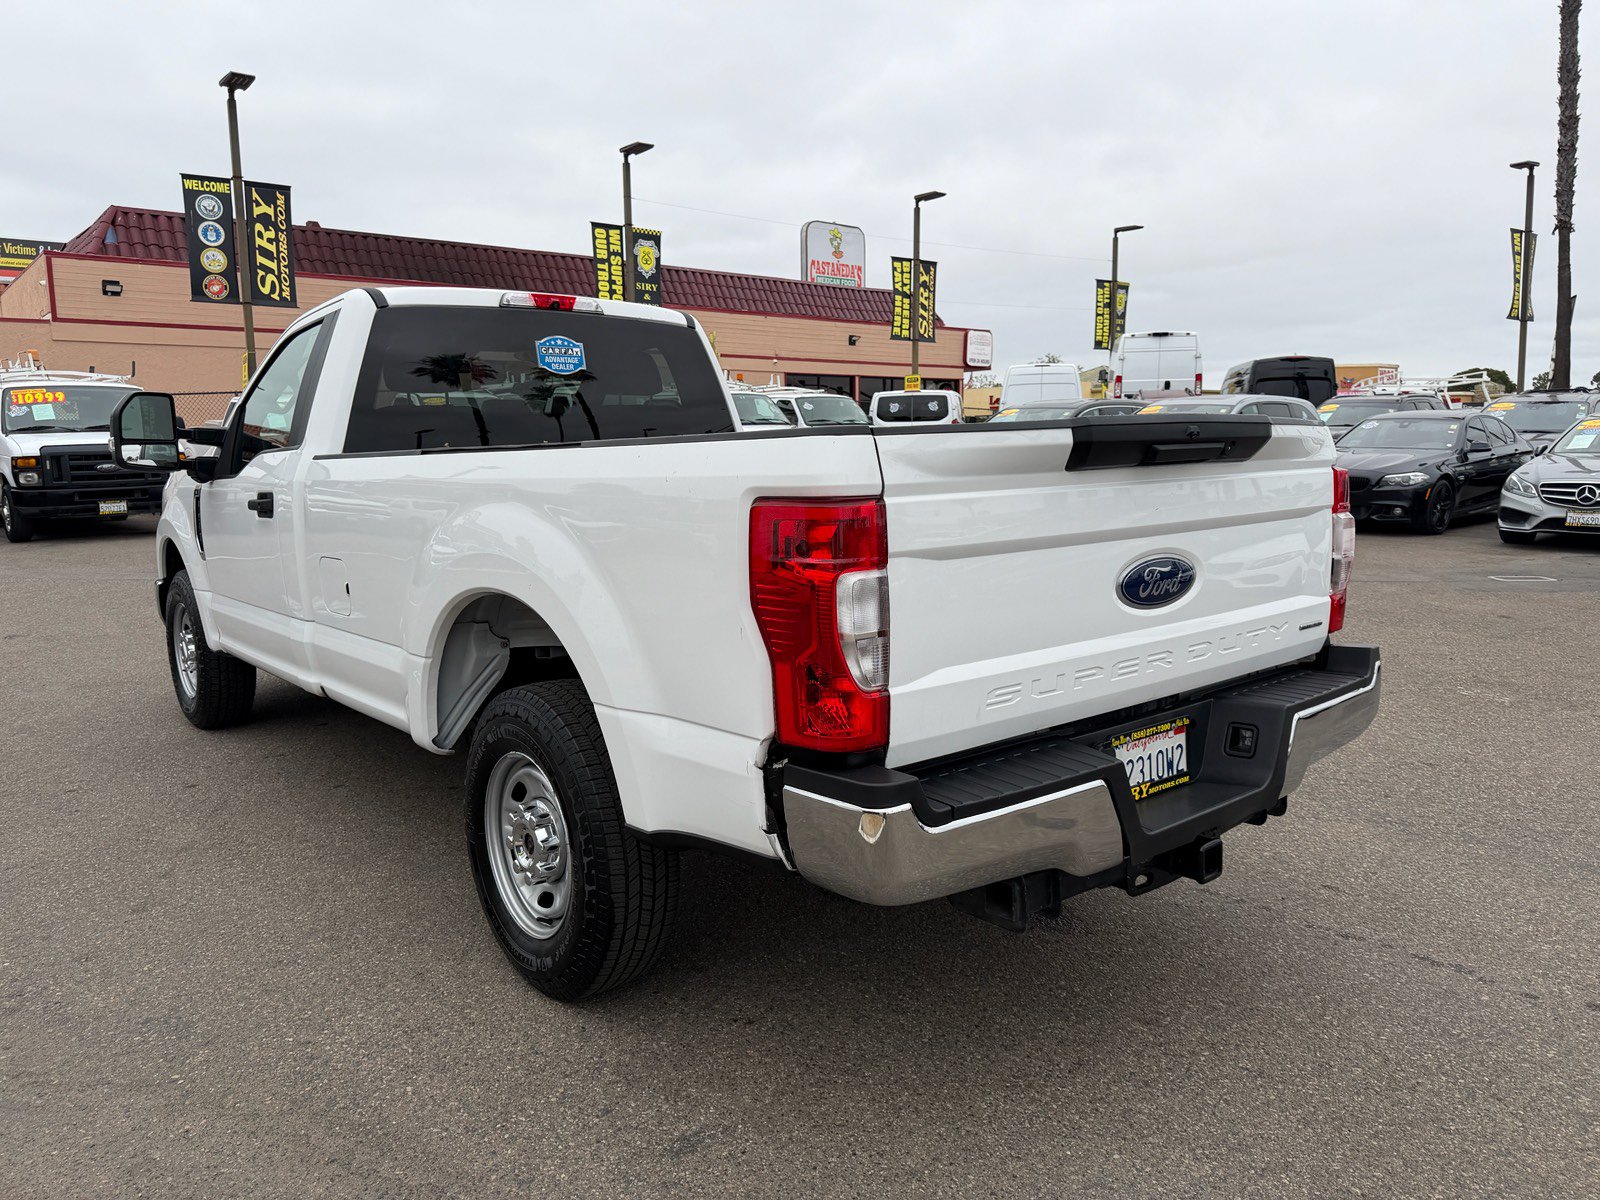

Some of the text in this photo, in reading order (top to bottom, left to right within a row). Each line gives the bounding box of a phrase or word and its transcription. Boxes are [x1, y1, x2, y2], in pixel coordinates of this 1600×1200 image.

[184, 179, 230, 194] WELCOME
[3, 242, 37, 256] Victims
[252, 187, 280, 301] SIRY
[594, 228, 608, 259] OUR
[609, 229, 621, 253] WE
[636, 282, 658, 292] SIRY
[893, 261, 902, 336] PAY HERE
[902, 261, 911, 338] BUY HERE
[919, 262, 930, 338] SIRY
[1102, 307, 1110, 348] SERVICE
[541, 347, 580, 356] CARFAX
[545, 356, 579, 364] ADVANTAGE
[1139, 565, 1182, 598] Ford
[985, 621, 1289, 710] SUPER DUTY
[1126, 731, 1174, 753] California
